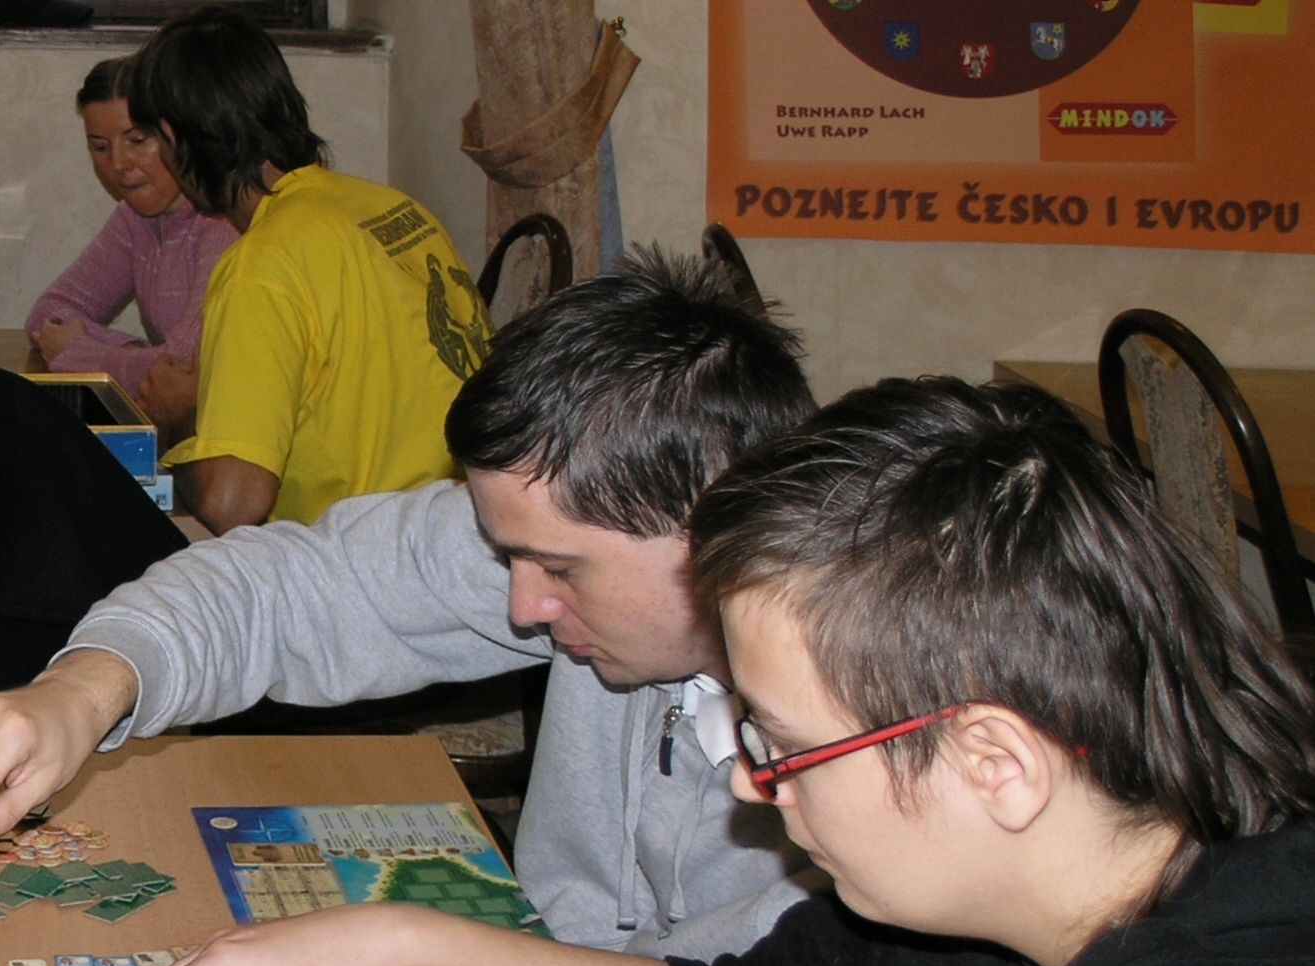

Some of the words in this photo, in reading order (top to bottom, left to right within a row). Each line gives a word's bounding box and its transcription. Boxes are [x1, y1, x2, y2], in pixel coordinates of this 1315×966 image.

[776, 105, 874, 119] BERNHARD
[880, 106, 926, 120] LACH
[1059, 108, 1167, 129] MINDOK
[776, 125, 816, 138] UWE
[820, 125, 869, 139] RAPP
[735, 184, 938, 223] POZNEJTE
[957, 182, 1089, 227] ČESKO
[1107, 196, 1118, 227] I
[1136, 199, 1301, 234] EVROPU
